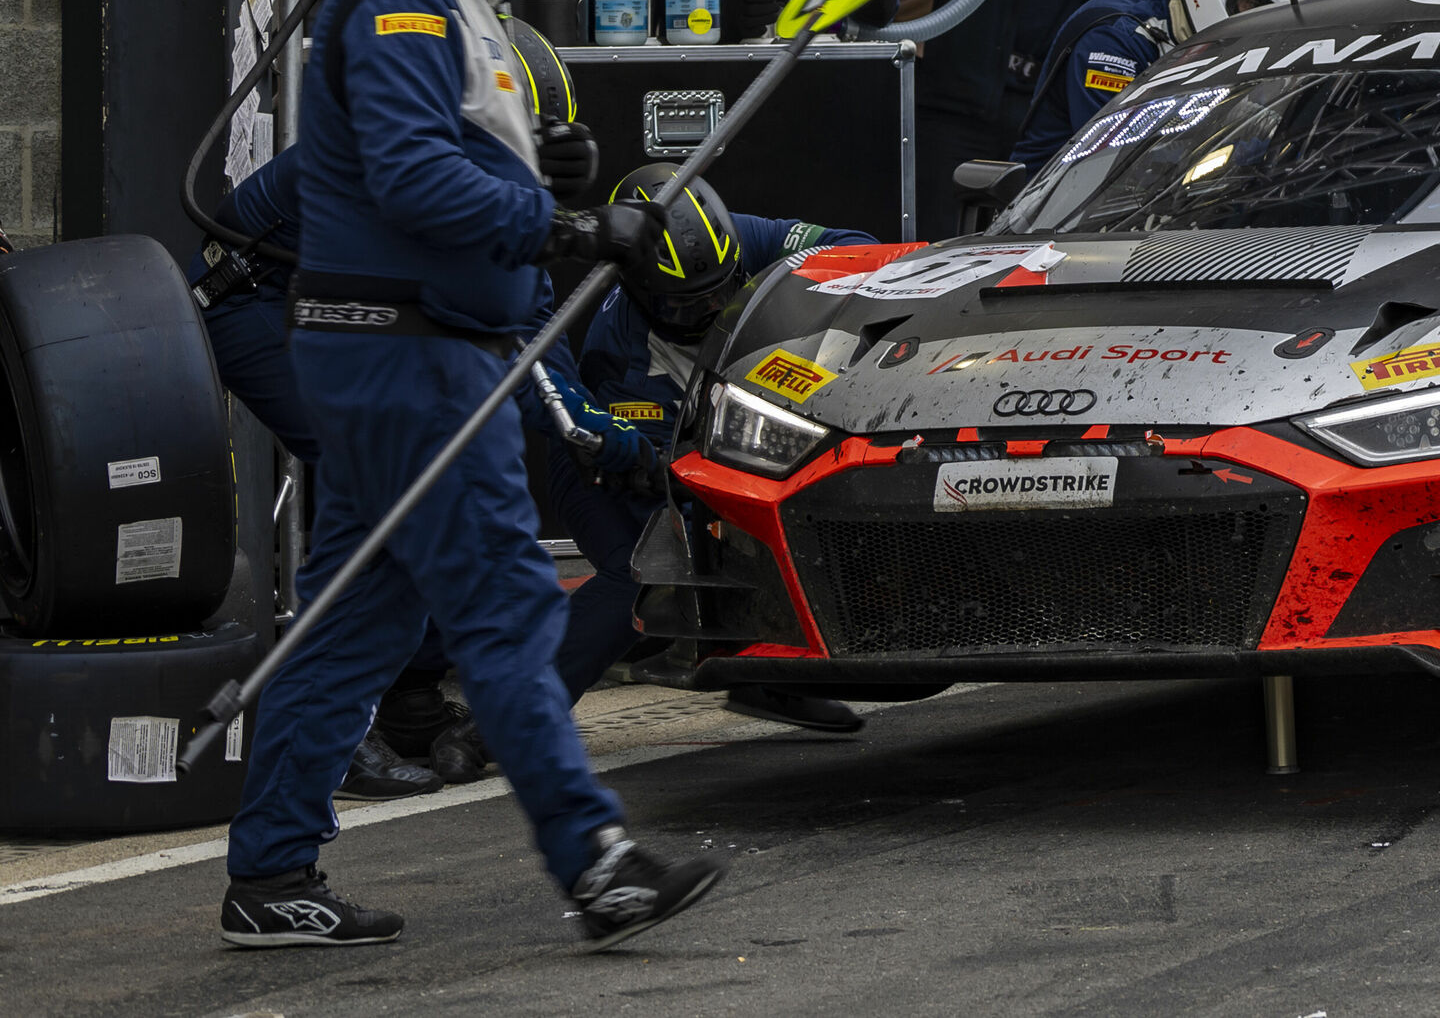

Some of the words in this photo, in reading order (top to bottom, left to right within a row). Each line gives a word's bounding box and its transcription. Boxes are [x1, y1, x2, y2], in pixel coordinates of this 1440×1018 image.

[994, 345, 1095, 363] Audi
[1100, 344, 1233, 364] Sport
[756, 356, 824, 396] PIRELLI
[954, 473, 1110, 494] CROWDSTRIKE
